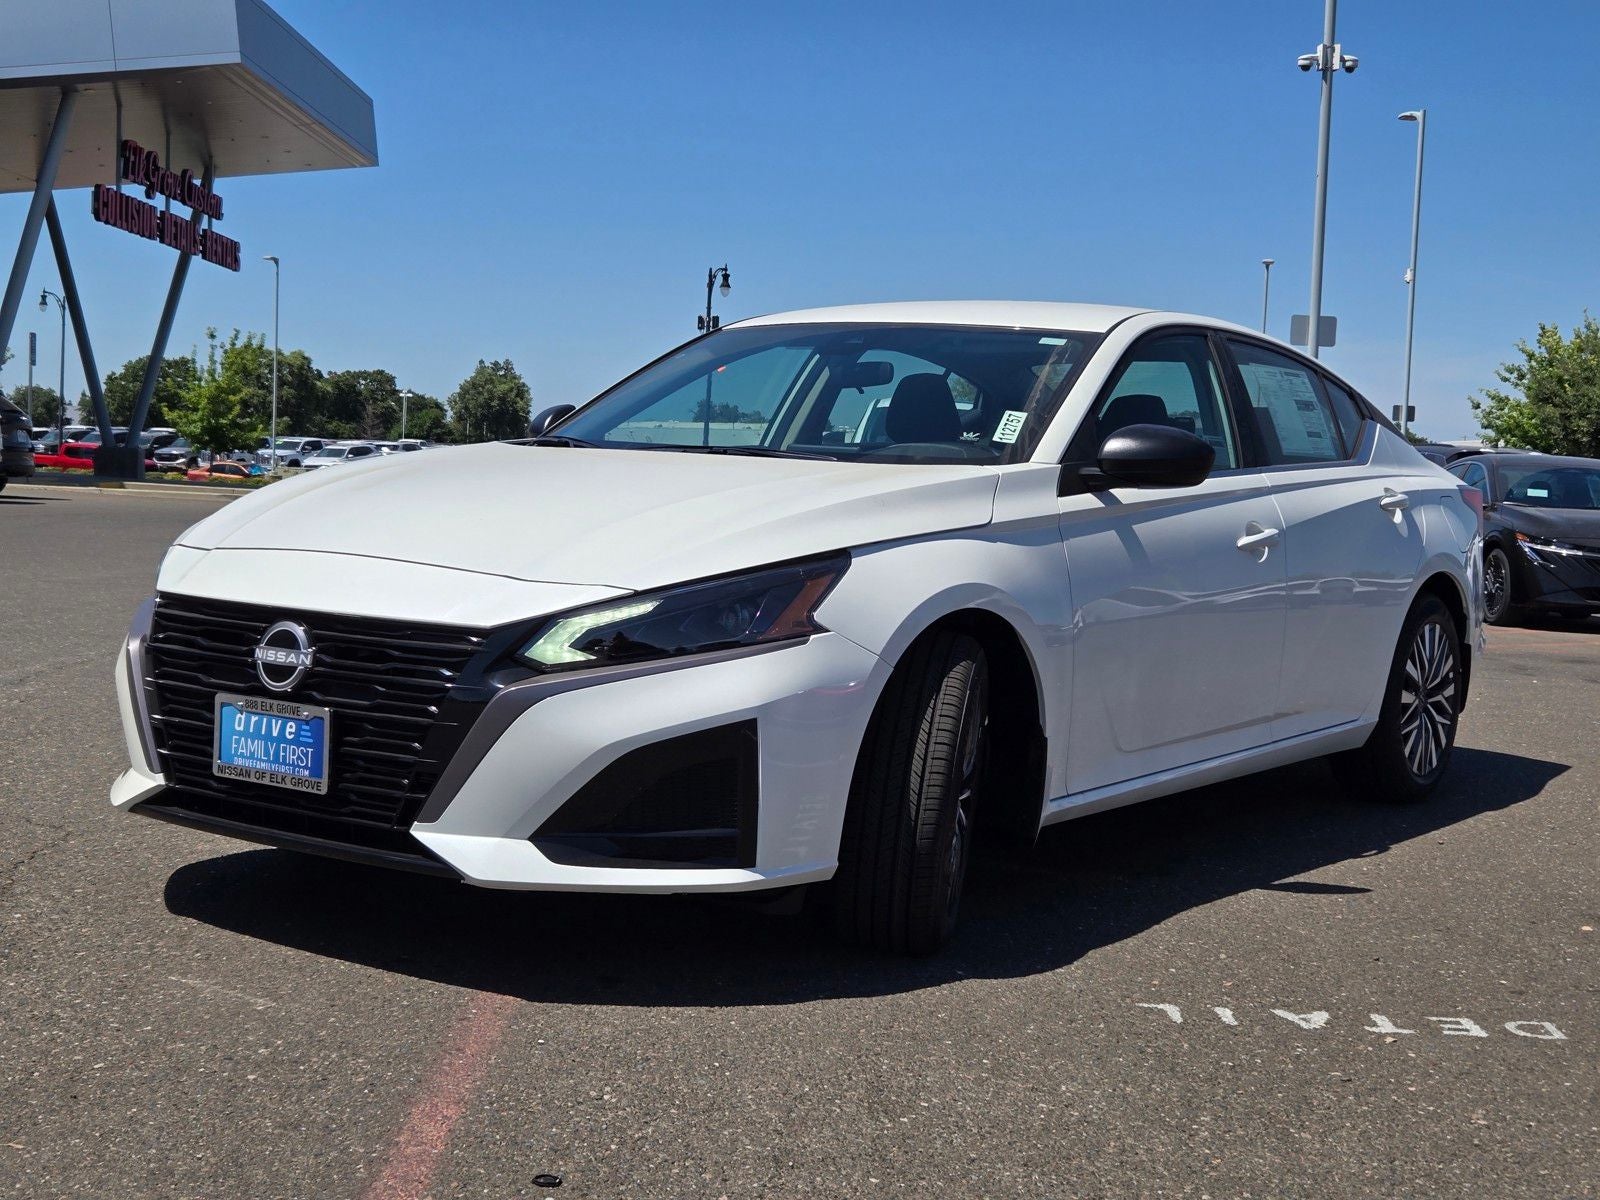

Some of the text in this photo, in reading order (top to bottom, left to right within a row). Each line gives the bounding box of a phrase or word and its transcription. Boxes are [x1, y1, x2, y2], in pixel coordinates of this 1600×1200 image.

[121, 139, 224, 221] Elk Grove Custom
[94, 183, 158, 242] COLLISION
[202, 228, 242, 273] RENTALS
[998, 413, 1023, 441] 112757
[254, 647, 311, 665] NISSAN
[244, 699, 301, 717] 888 ELK GROVE
[234, 711, 296, 740] drive
[231, 735, 314, 768] FAMILY FIRST
[217, 764, 322, 792] NISSAN OF ELK GROVE
[233, 757, 310, 777] DRIVEFAMILYFIRST.COM
[1135, 1002, 1568, 1040] DETAIL
